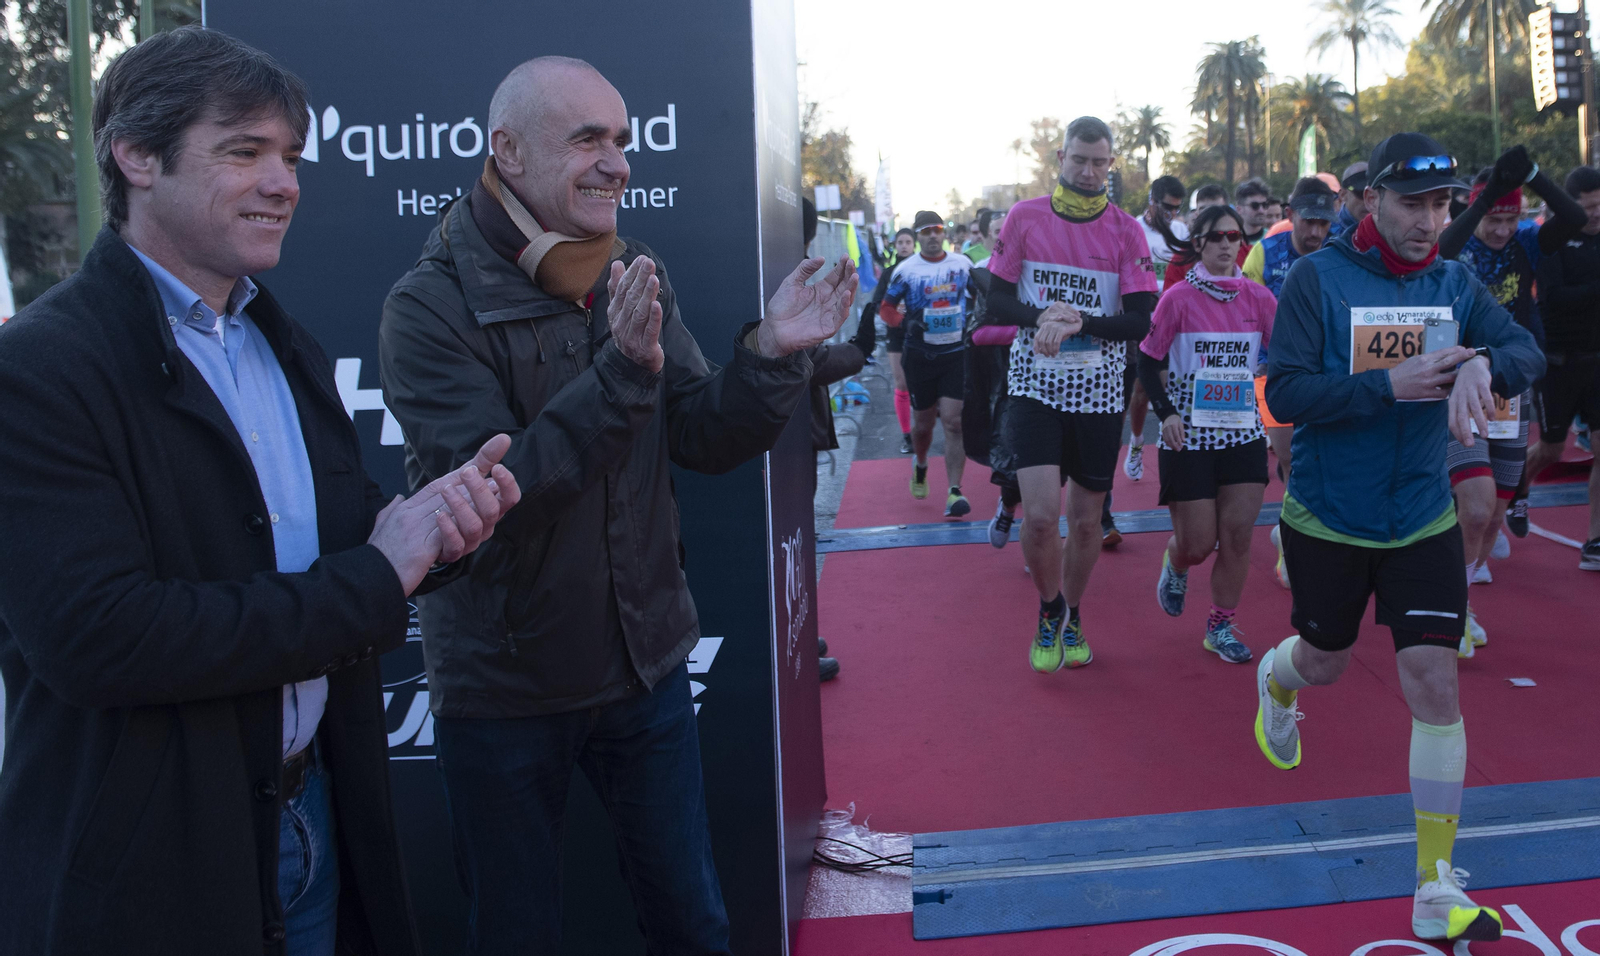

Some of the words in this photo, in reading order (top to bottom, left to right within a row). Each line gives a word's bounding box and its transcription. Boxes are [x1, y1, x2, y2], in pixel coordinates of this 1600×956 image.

[1033, 269, 1097, 293] ENTRENA
[932, 316, 953, 329] 948
[1376, 311, 1394, 323] edp
[1406, 310, 1436, 318] maratón
[1194, 341, 1250, 354] ENTRENA
[1203, 384, 1240, 402] 2931
